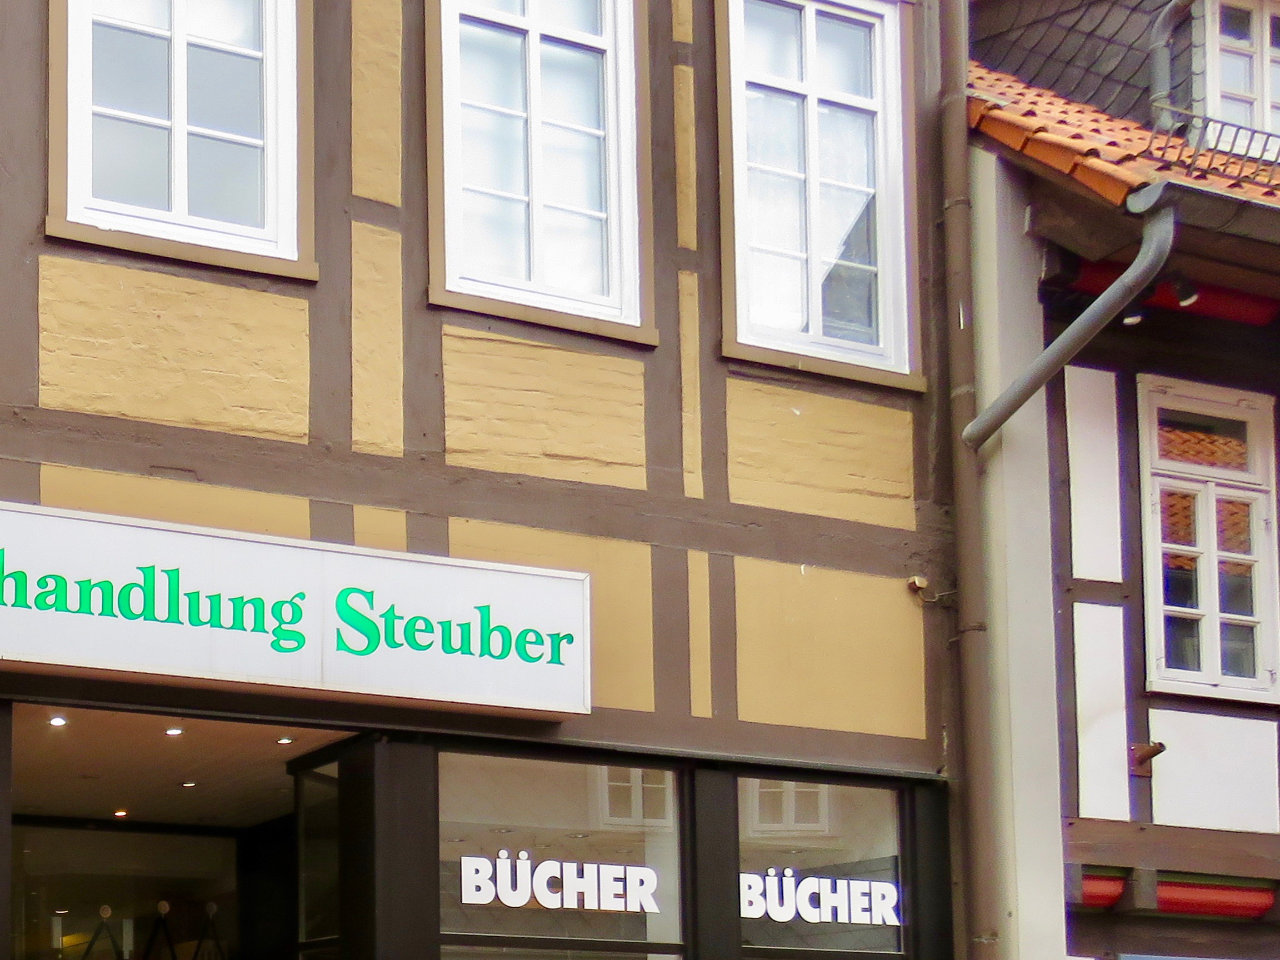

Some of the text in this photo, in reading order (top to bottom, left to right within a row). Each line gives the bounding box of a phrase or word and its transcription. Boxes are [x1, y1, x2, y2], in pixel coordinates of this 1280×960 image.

[334, 587, 575, 667] Steuber
[460, 849, 661, 914] BÜCHER
[739, 868, 901, 926] BÜCHER
